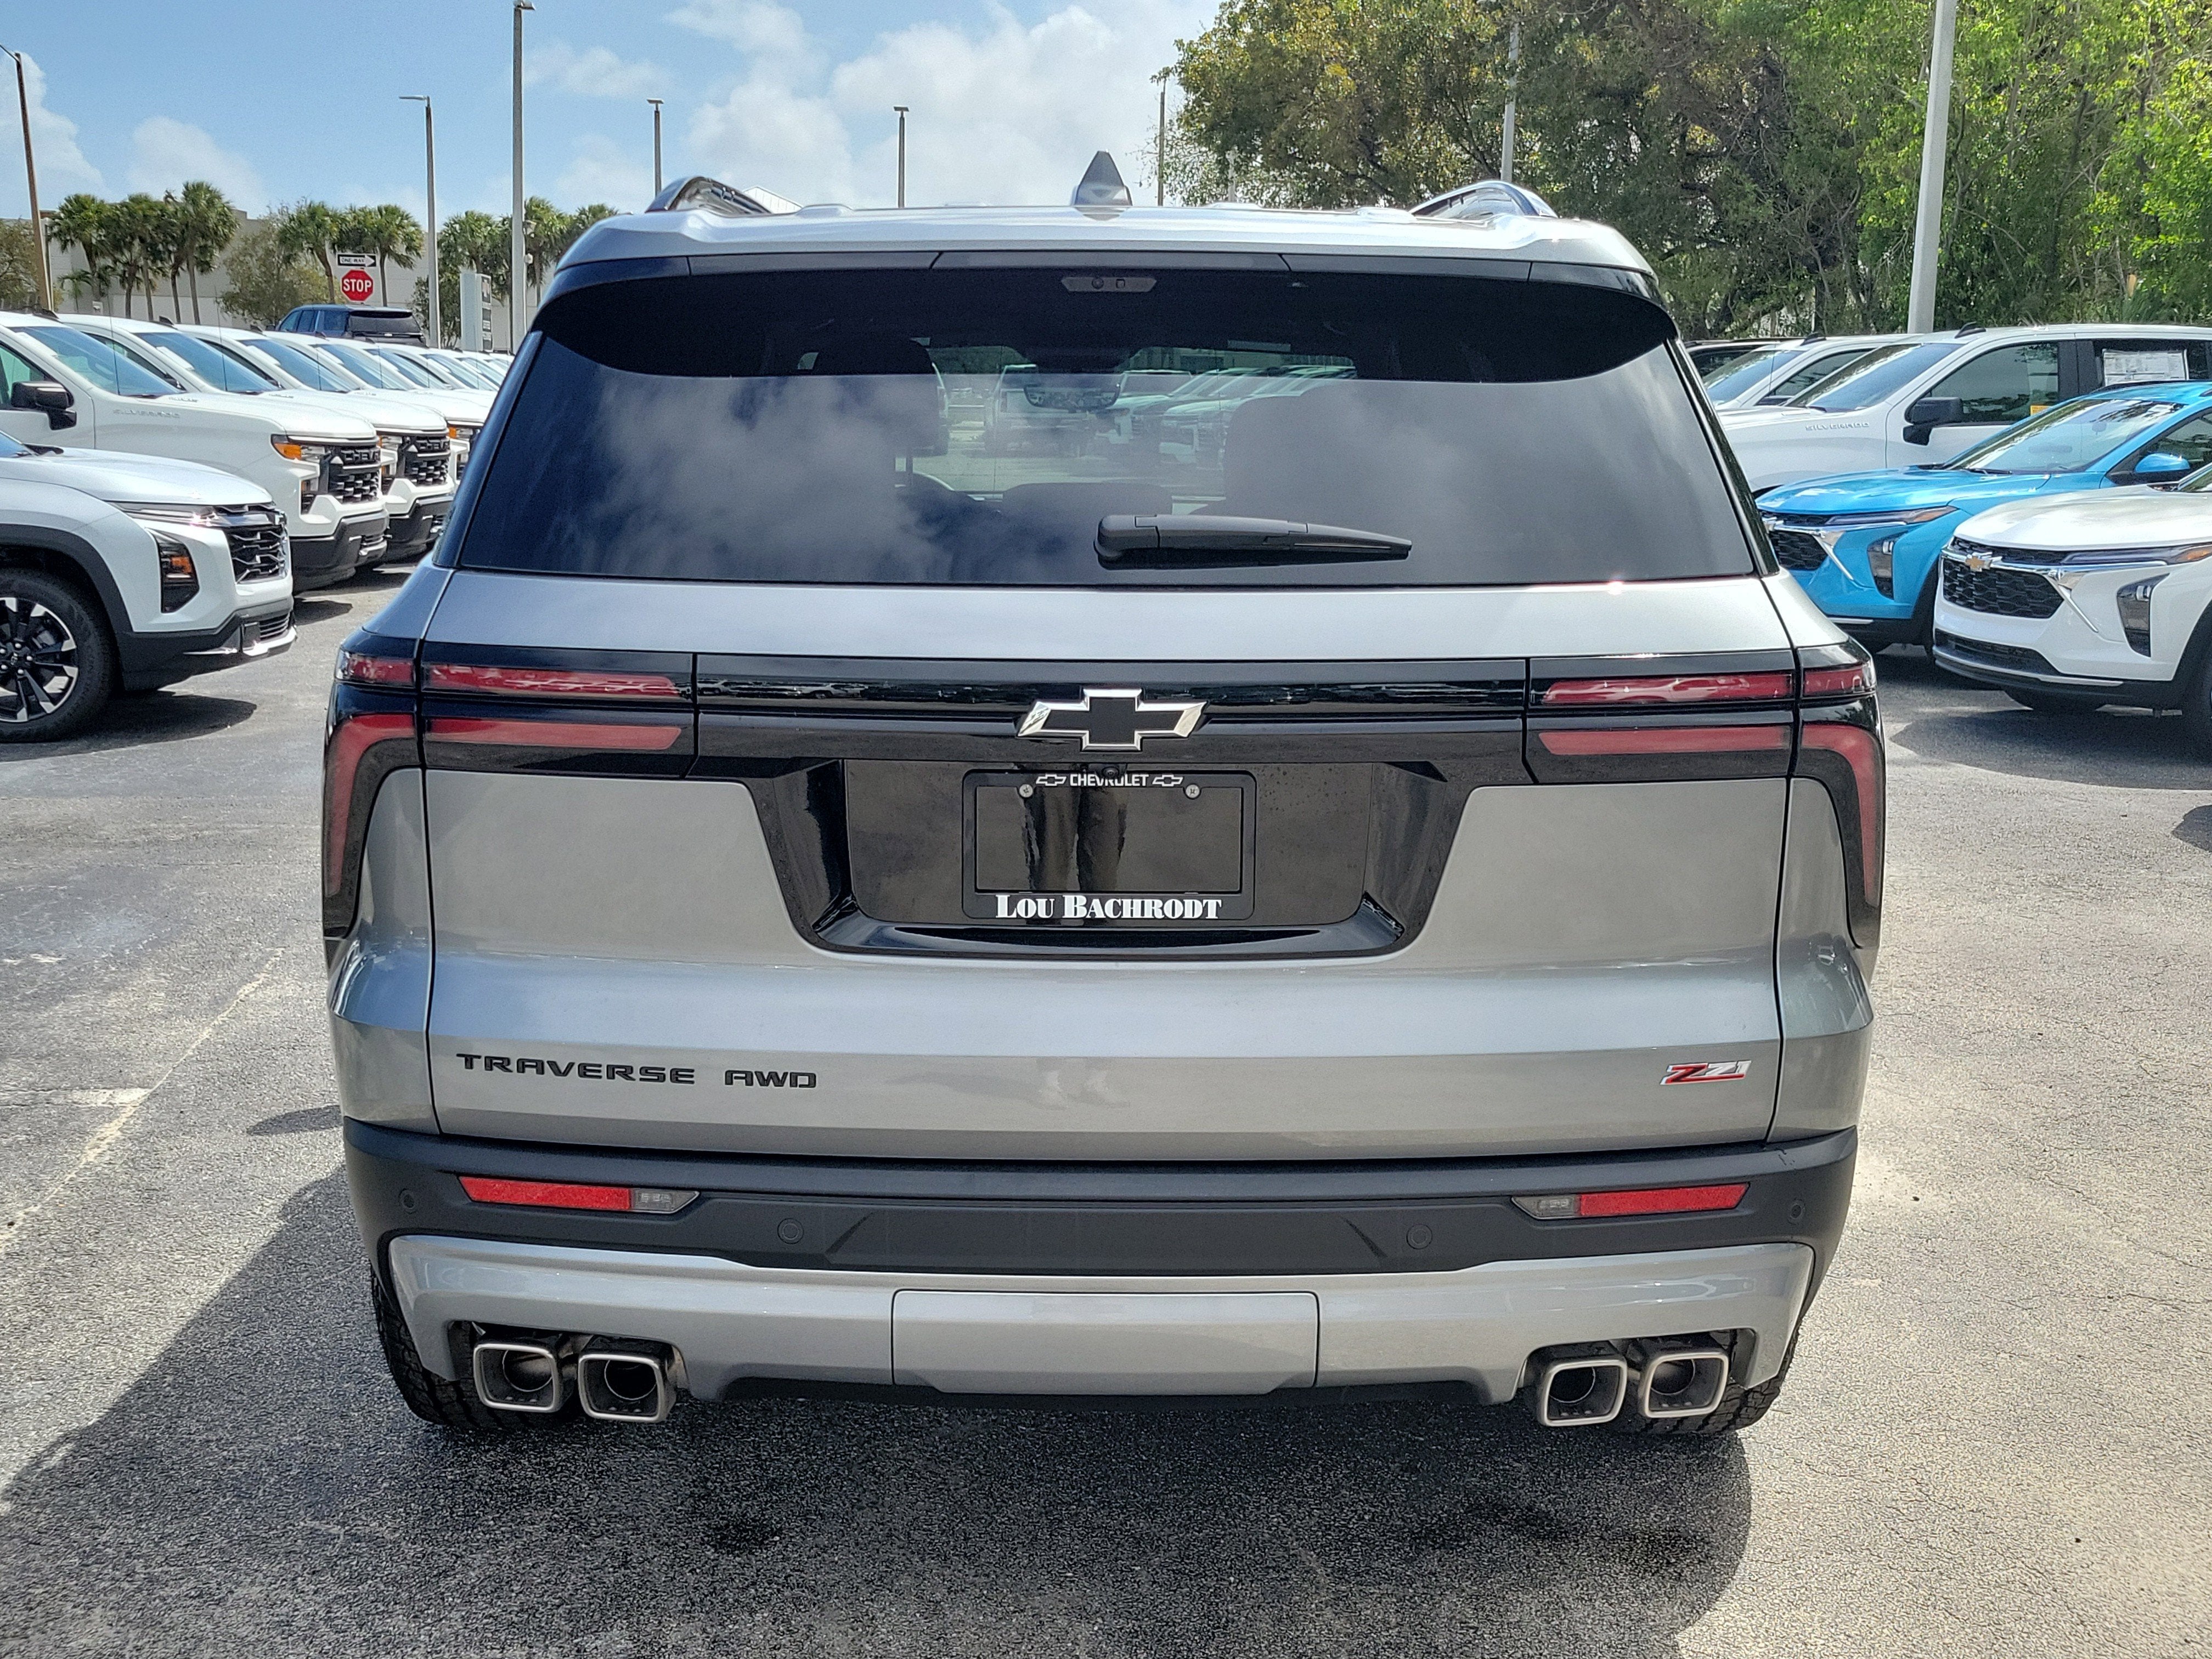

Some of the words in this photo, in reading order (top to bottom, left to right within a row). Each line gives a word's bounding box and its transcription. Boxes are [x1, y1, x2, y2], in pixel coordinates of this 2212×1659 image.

[343, 279, 372, 292] STOP
[1805, 422, 1870, 431] SILVERADO
[995, 894, 1054, 918] LOU
[1062, 894, 1222, 919] BACHRODT
[456, 1053, 696, 1084] TRAVERSE
[724, 1069, 817, 1088] AWD
[1660, 1060, 1752, 1085] Z71
